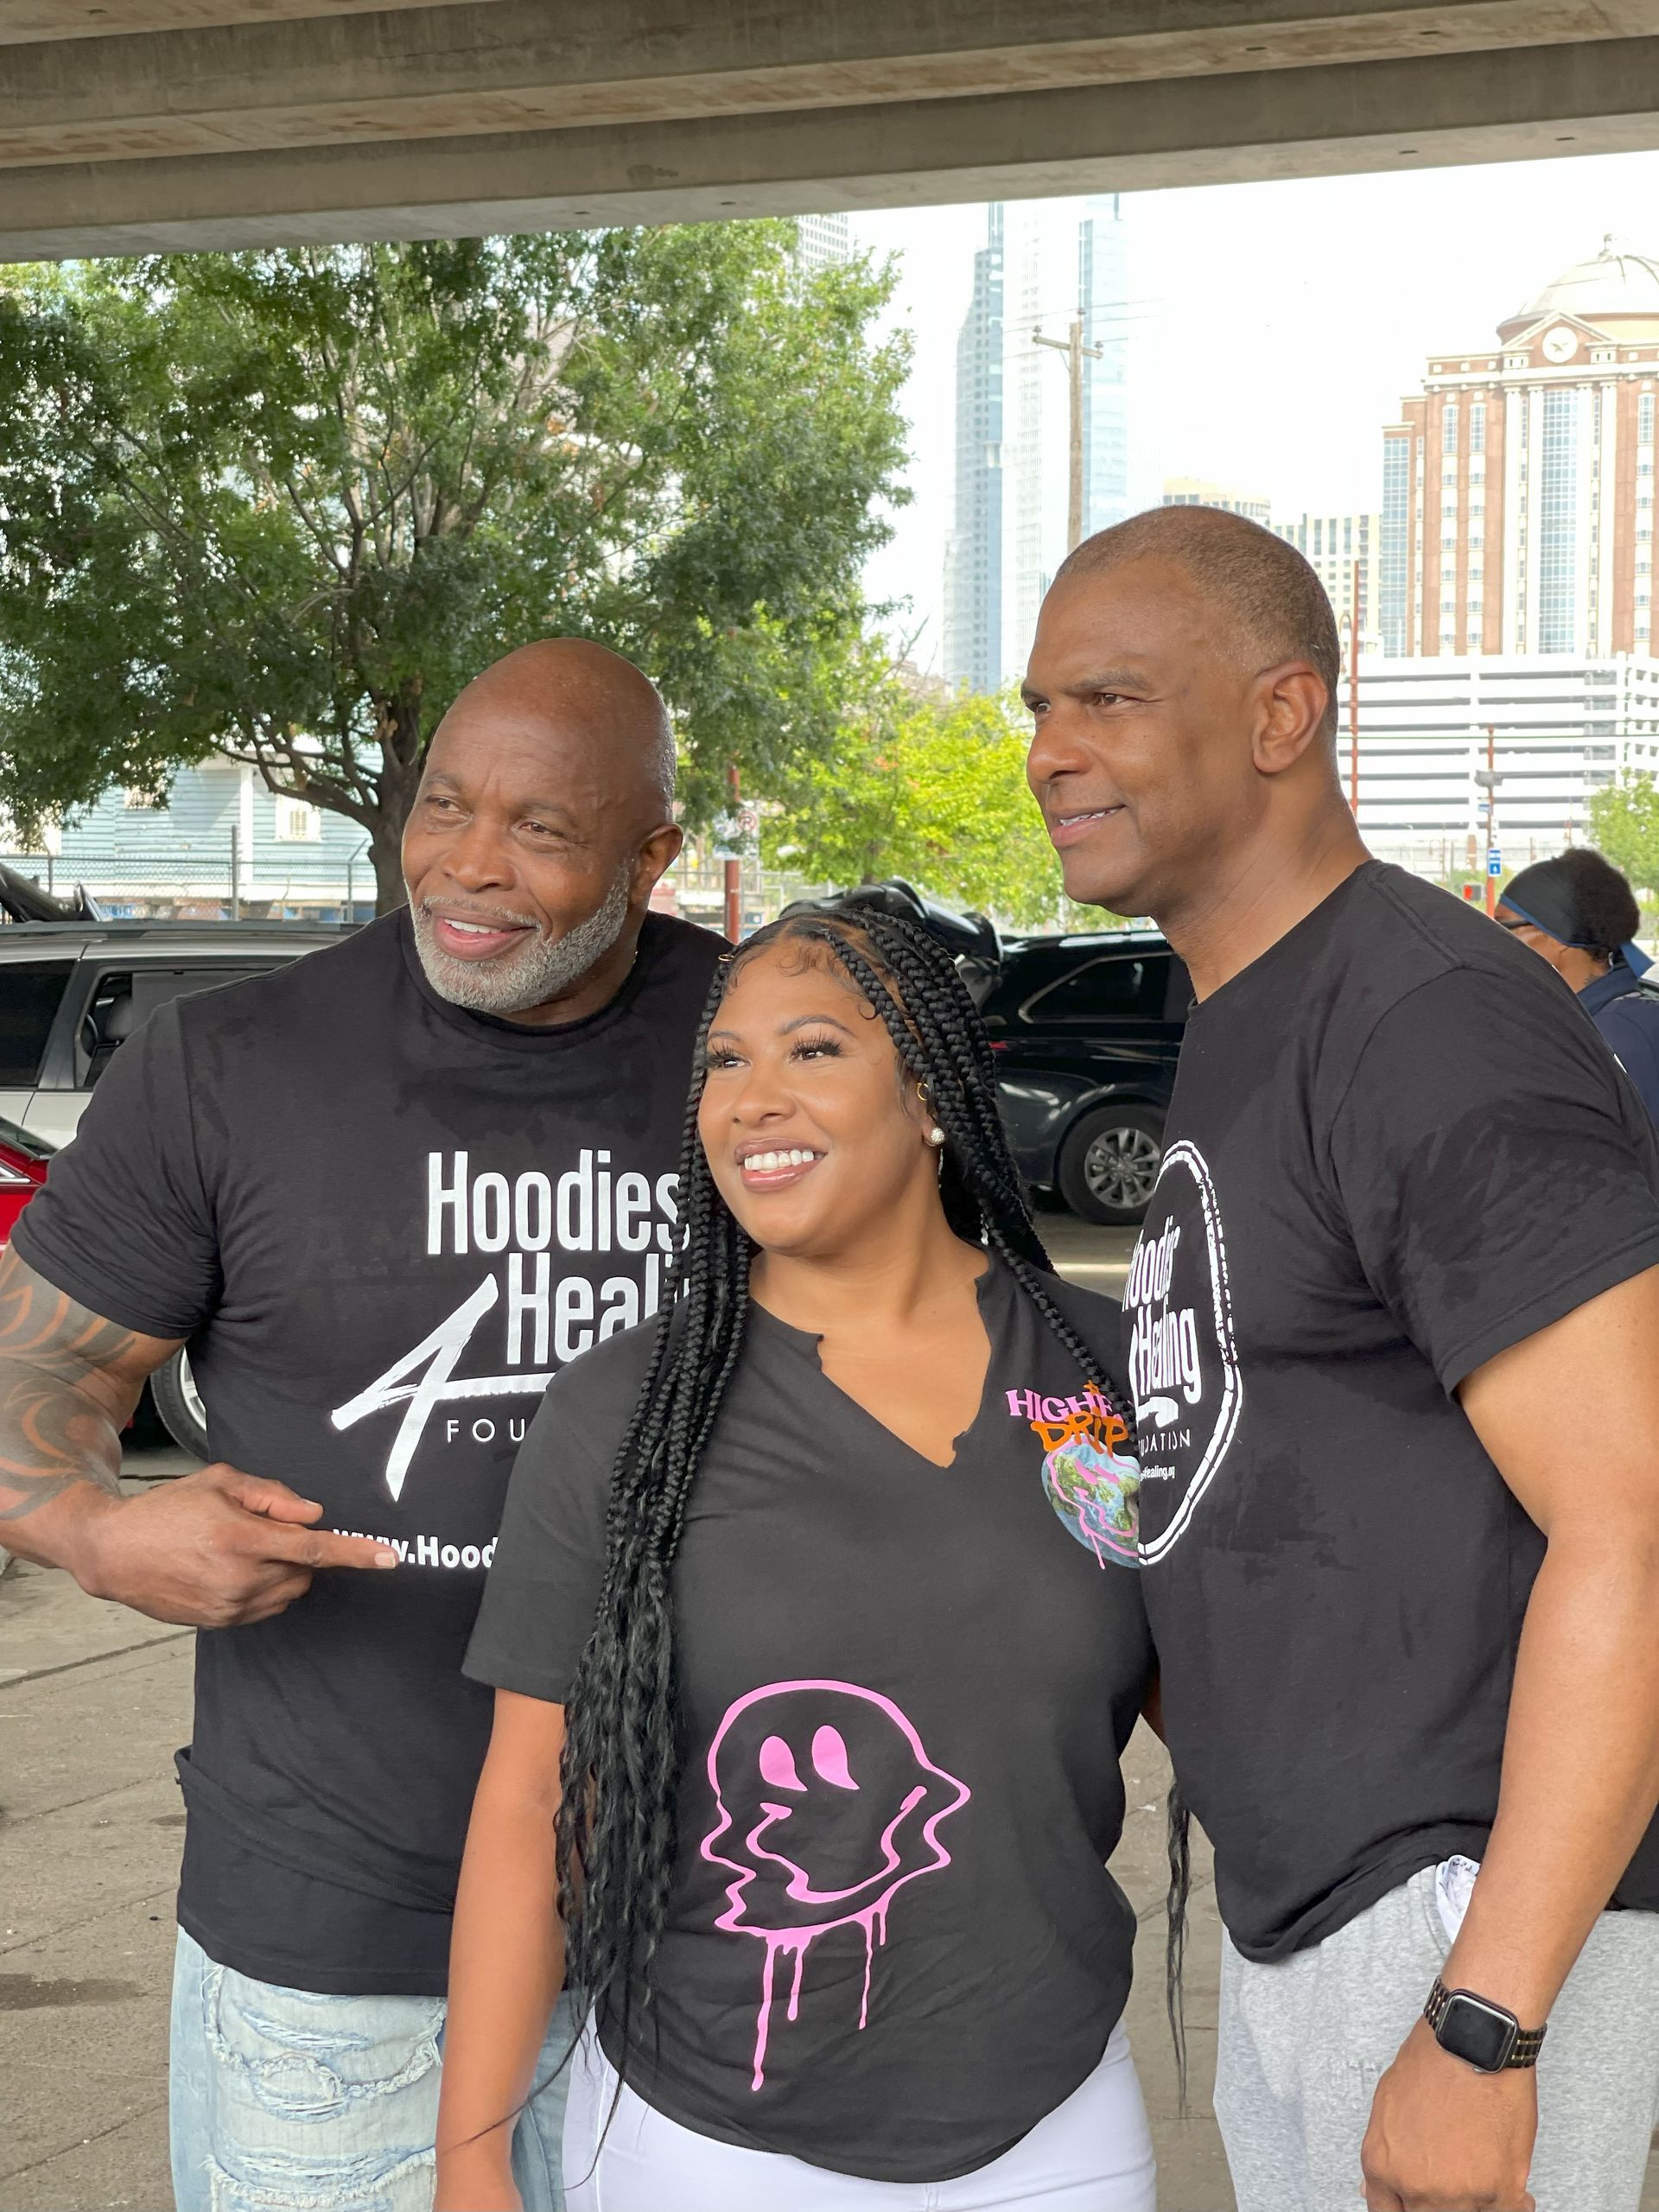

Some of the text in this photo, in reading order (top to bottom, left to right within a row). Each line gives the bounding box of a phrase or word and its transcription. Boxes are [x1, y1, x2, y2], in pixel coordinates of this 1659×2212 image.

[427, 1149, 690, 1255] Hoodies
[331, 1272, 556, 1503] 4
[1006, 1389, 1130, 1423] HIGHE
[1030, 1407, 1128, 1458] DRIP
